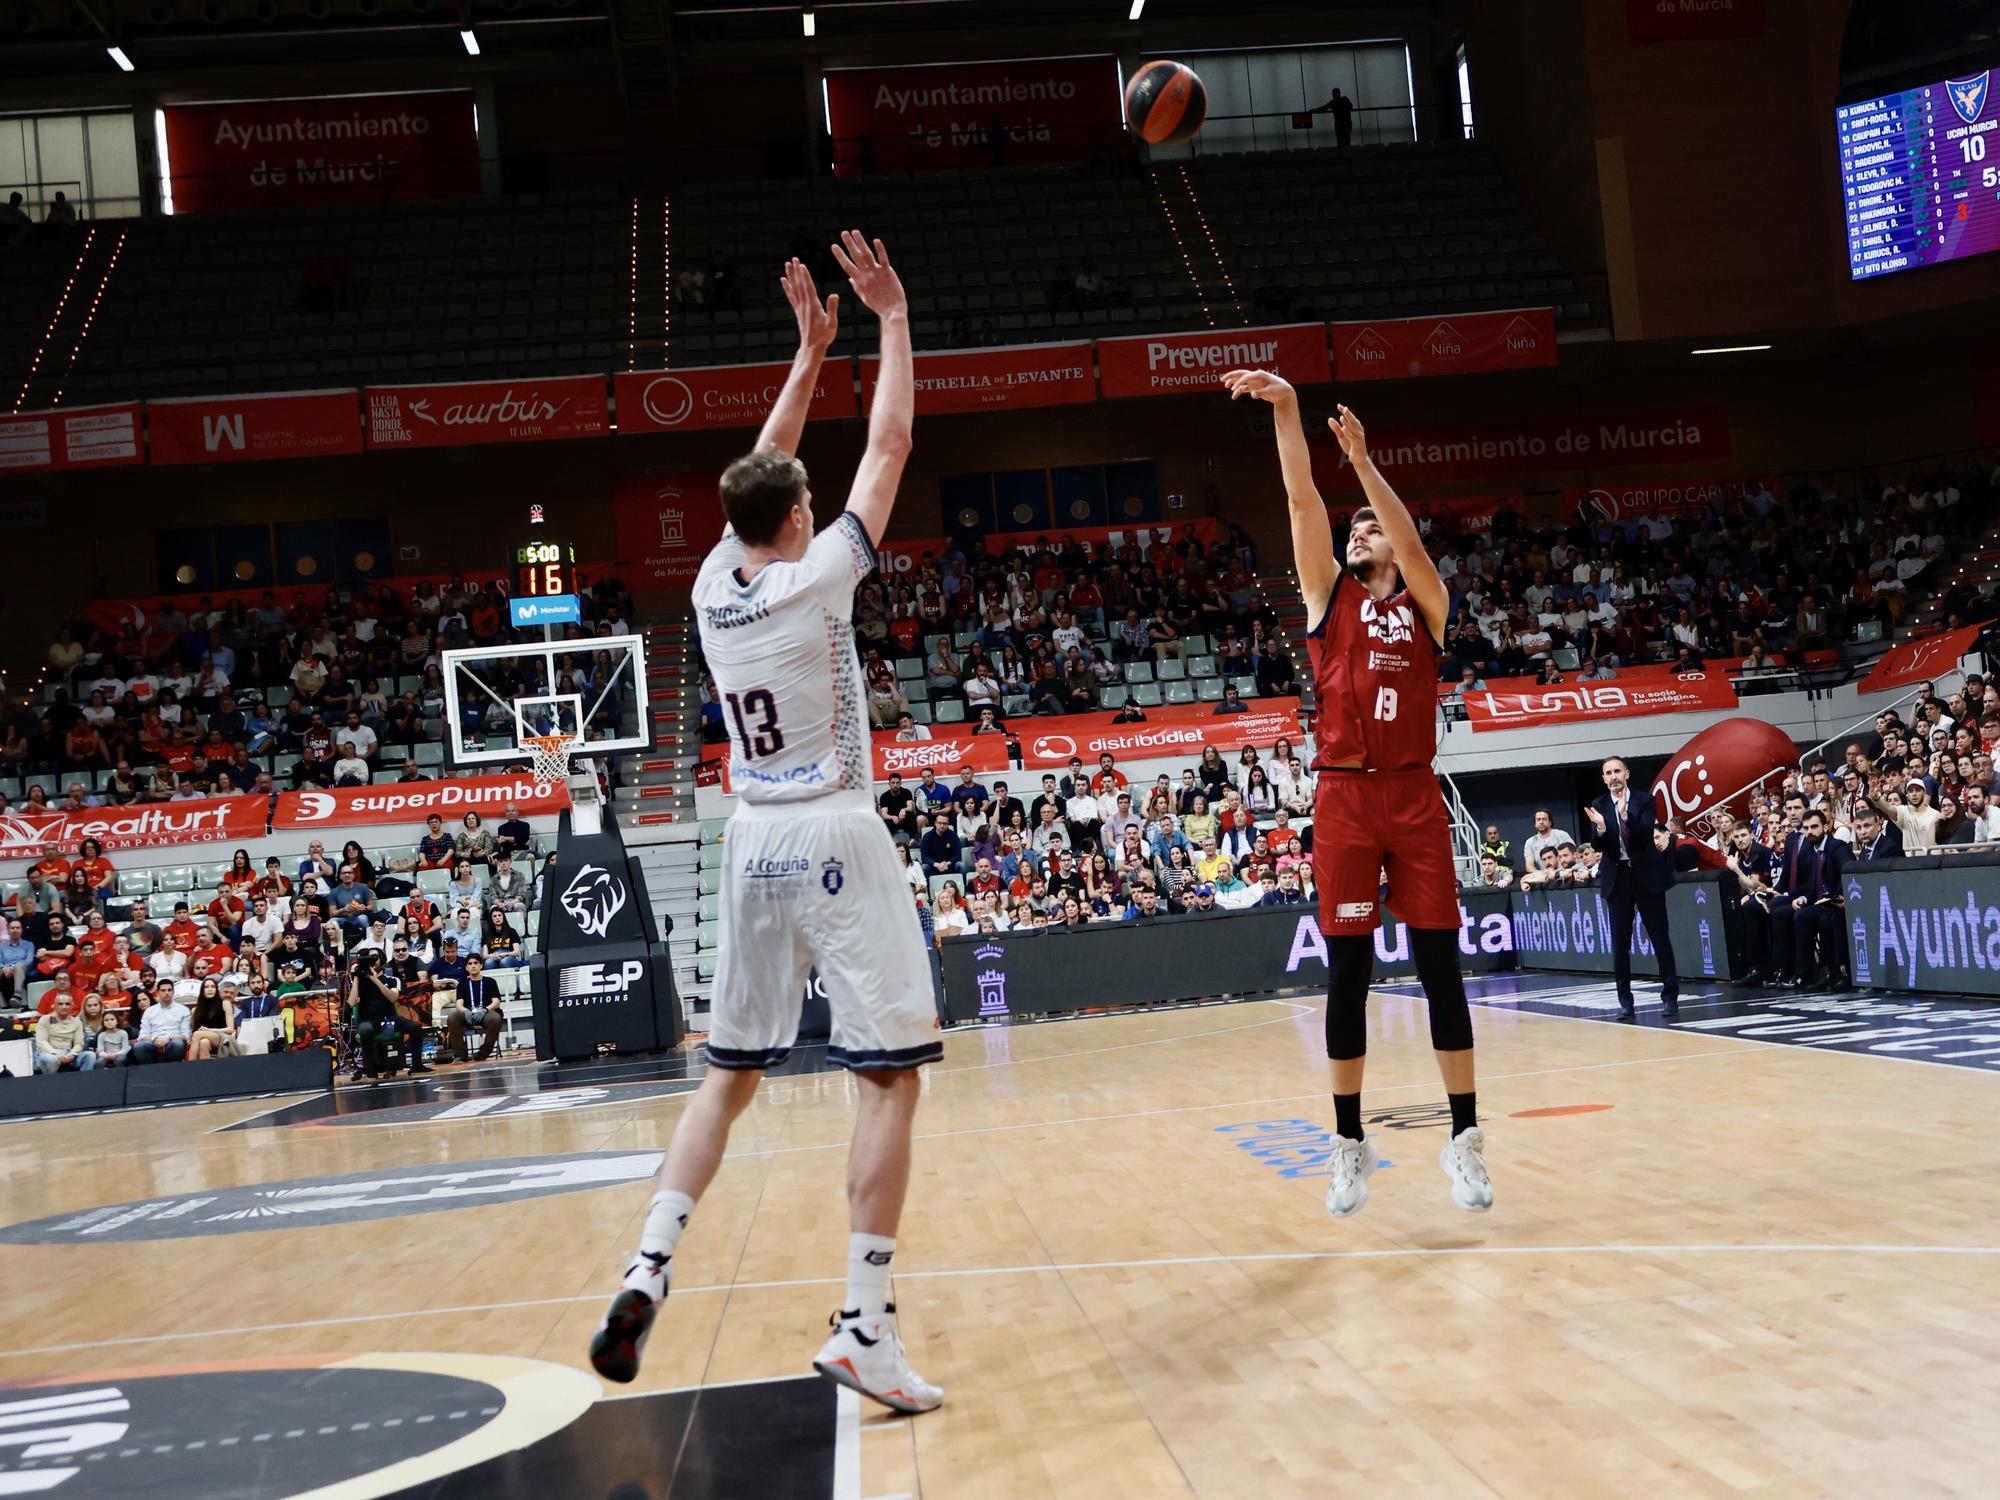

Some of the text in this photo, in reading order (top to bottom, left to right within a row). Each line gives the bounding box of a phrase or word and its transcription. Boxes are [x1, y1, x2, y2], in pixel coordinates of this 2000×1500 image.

[874, 77, 1076, 114] Ayuntamiento
[1925, 89, 1930, 97] 0
[1926, 102, 1931, 111] 3
[214, 112, 430, 149] Ayuntamiento
[1842, 135, 1850, 144] 10
[1928, 115, 1933, 124] 0
[1844, 148, 1850, 157] 11
[1929, 128, 1934, 137] 0
[1947, 120, 1998, 139] UCAM MURCIA
[1844, 142, 1935, 170] 12 RADEBAUGH 3
[1960, 135, 1985, 163] 10
[250, 161, 288, 187] de
[1846, 174, 1854, 183] 14
[1931, 155, 1937, 164] 2
[1858, 180, 1894, 195] TODOROVIC
[1933, 168, 1938, 177] 2
[1849, 200, 1857, 209] 21
[1934, 182, 1939, 190] 0
[1849, 214, 1858, 222] 22
[1935, 195, 1940, 204] 0
[1851, 227, 1859, 236] 25
[1937, 208, 1942, 217] 0
[1957, 203, 1968, 221] 3
[1852, 240, 1859, 249] 31
[1938, 222, 1943, 230] 0
[1853, 253, 1862, 262] 47
[1939, 235, 1944, 244] 0
[1881, 257, 1907, 271] ALONSO
[1147, 340, 1278, 371] Prevemur
[914, 375, 991, 390] STRELLA
[1007, 368, 1083, 385] LEVANTE
[443, 390, 570, 425] aurbús
[703, 390, 759, 408] Costa
[371, 408, 400, 419] HASTA
[373, 430, 412, 443] QUIERAS
[509, 425, 543, 438] TE LLEVA
[1556, 428, 1592, 455] de
[1600, 420, 1703, 451] Murcia
[526, 544, 560, 564] 5:00
[644, 554, 700, 567] Ayuntamient
[530, 565, 562, 595] 16
[654, 569, 666, 578] de
[540, 606, 570, 615] Movistar
[1373, 685, 1398, 722] 19
[1648, 689, 1676, 698] socio
[725, 688, 784, 761] 13
[1232, 716, 1291, 727] veggies para
[1246, 725, 1281, 734] cocinas
[1089, 728, 1205, 752] distribudiet
[350, 781, 553, 813] superDumbo
[64, 802, 232, 840] realturf
[744, 856, 809, 873] A Coruña
[558, 994, 629, 1008] SOLUTIONS
